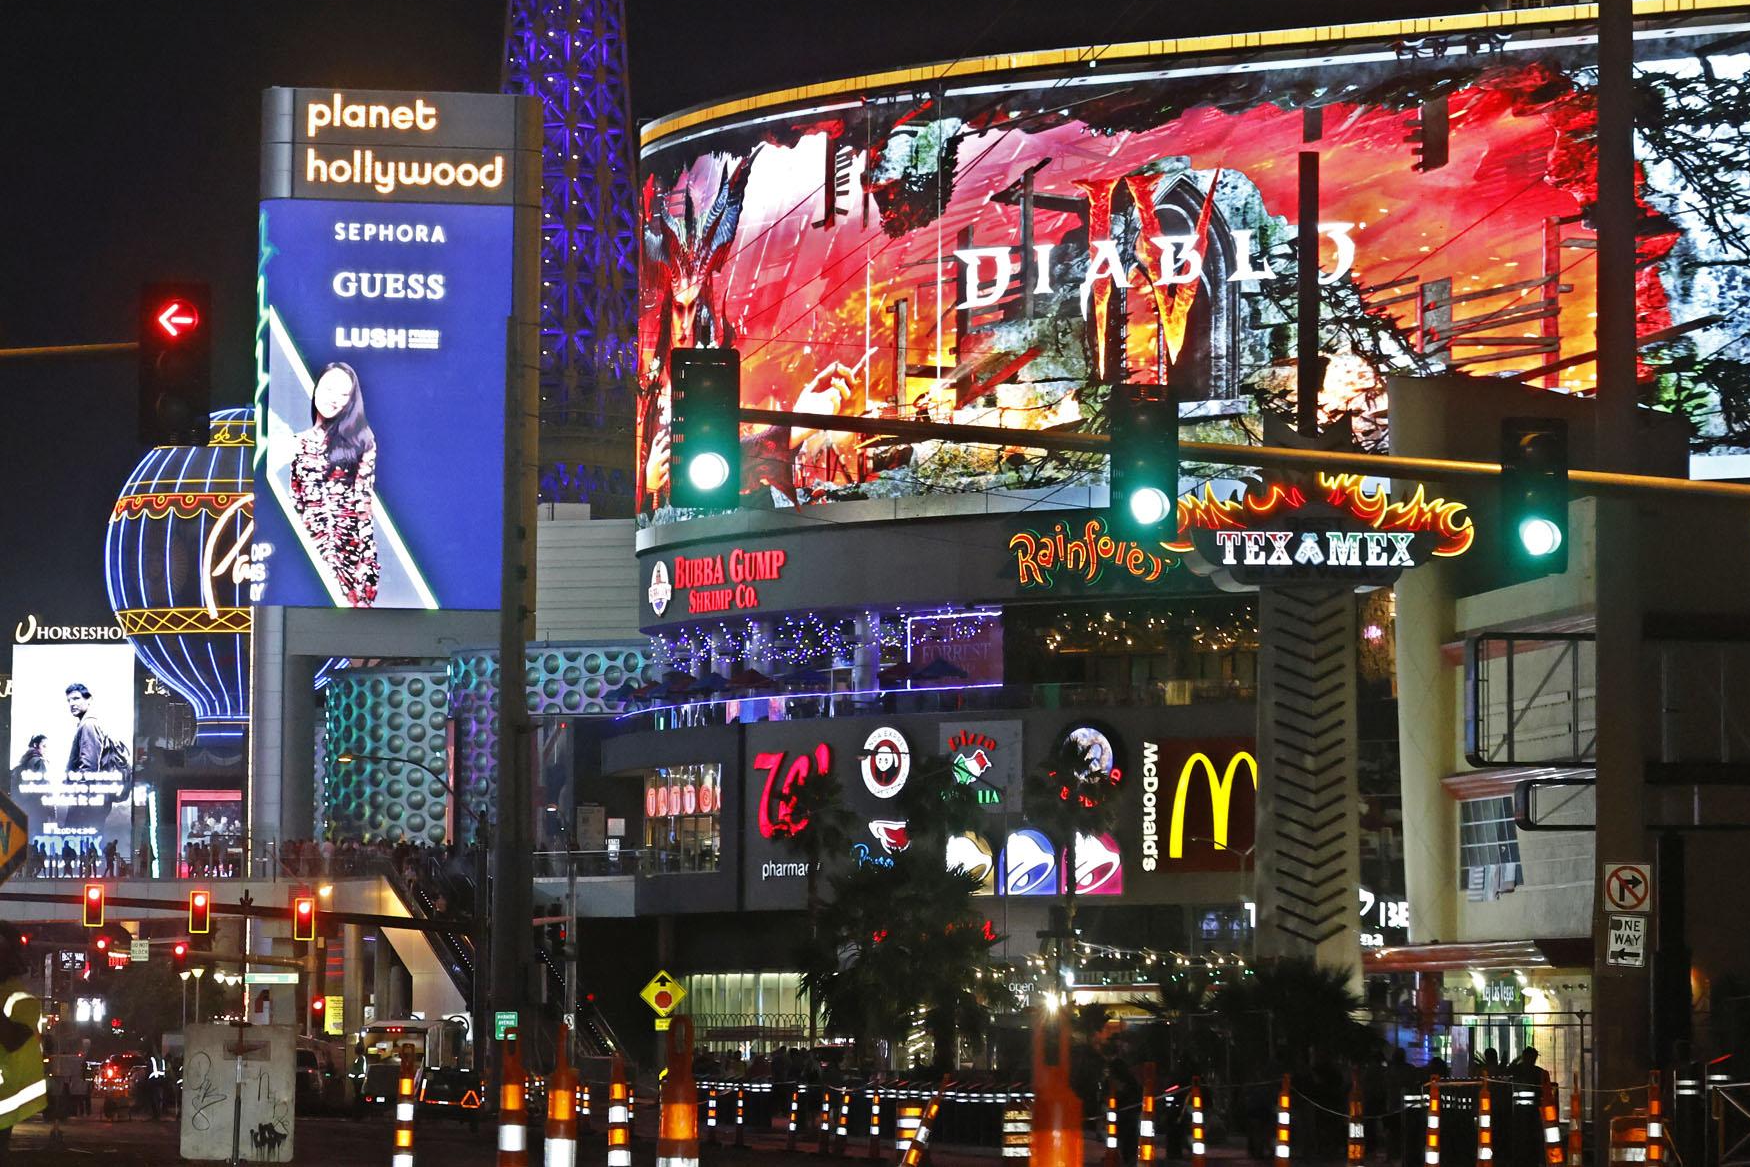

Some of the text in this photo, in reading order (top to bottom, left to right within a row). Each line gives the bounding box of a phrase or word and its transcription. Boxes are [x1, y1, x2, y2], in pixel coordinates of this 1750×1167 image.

[306, 93, 438, 137] planet
[306, 148, 505, 194] hollywood
[334, 222, 446, 243] SEPHORA
[332, 271, 446, 300] GUESS
[335, 327, 407, 349] LUSH
[674, 548, 786, 589] BUBBA GUMP
[688, 589, 733, 614] SHRIMP
[1142, 741, 1158, 872] McDonald's
[1614, 933, 1641, 945] WAY
[1008, 983, 1034, 997] open
